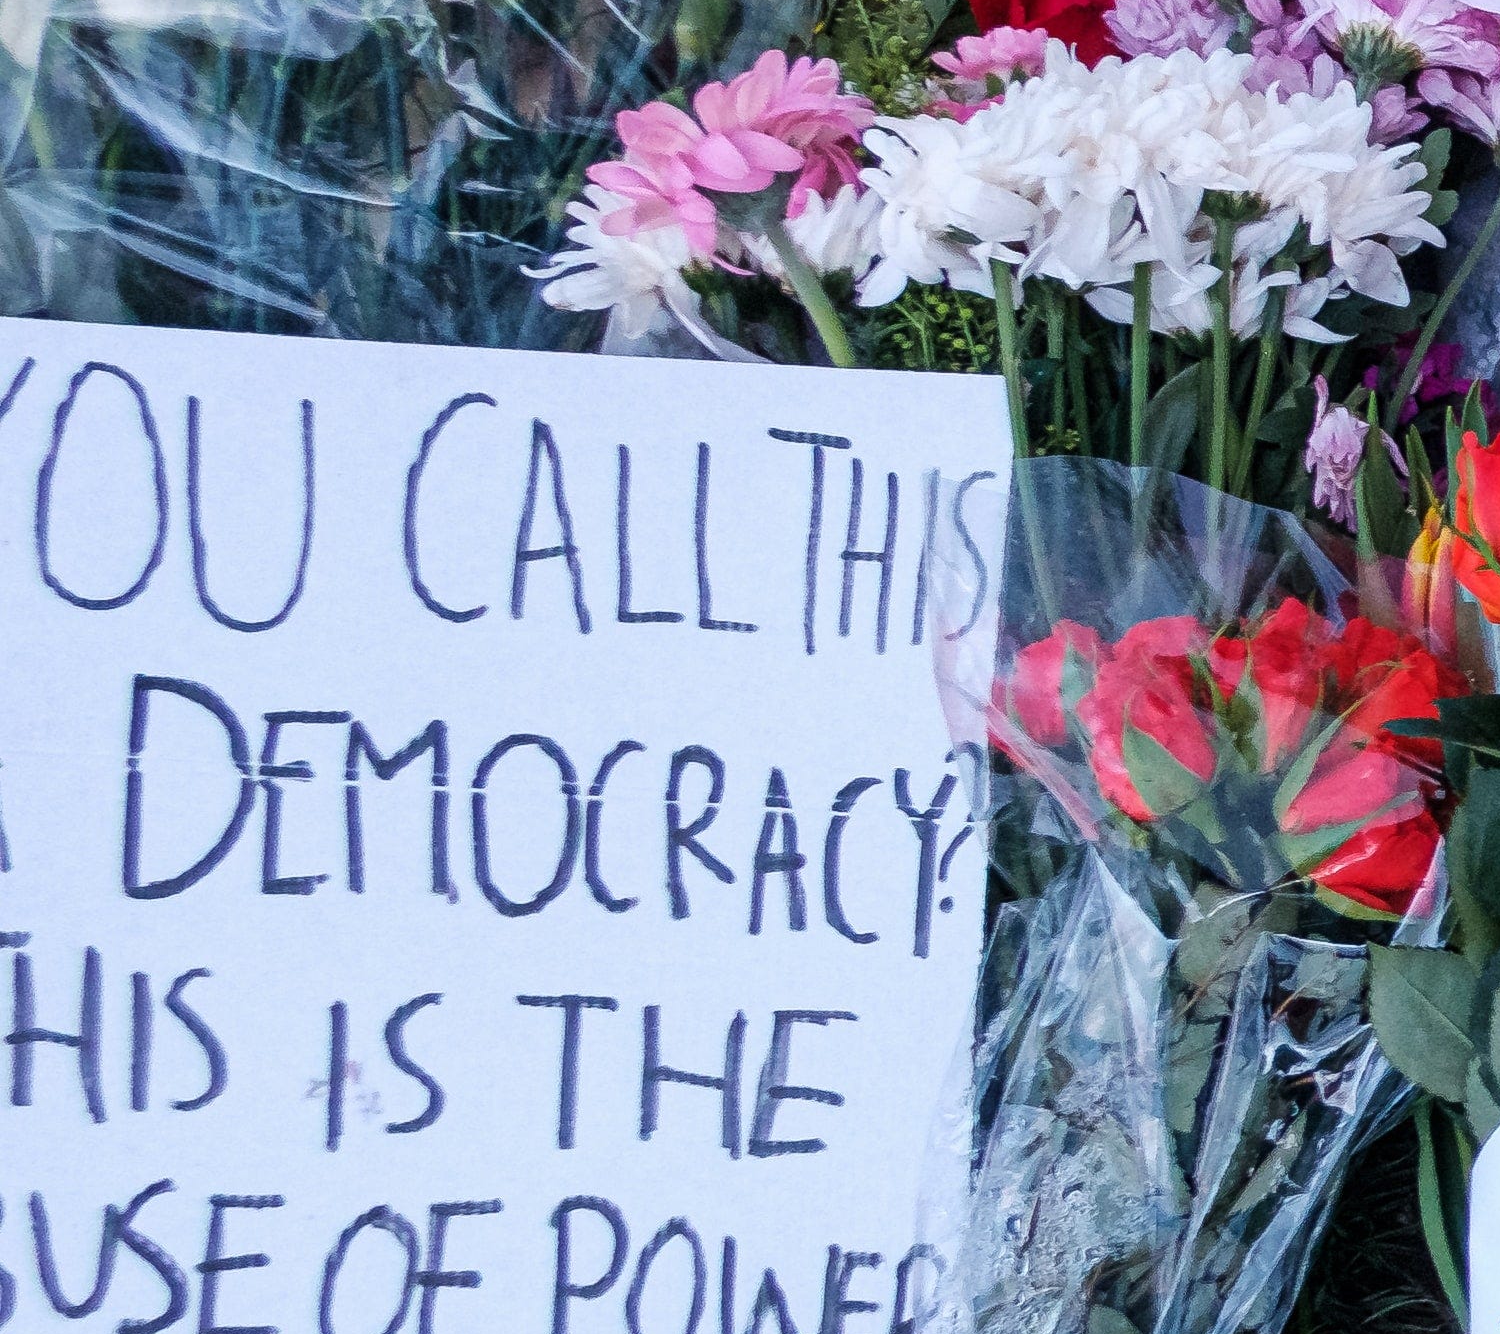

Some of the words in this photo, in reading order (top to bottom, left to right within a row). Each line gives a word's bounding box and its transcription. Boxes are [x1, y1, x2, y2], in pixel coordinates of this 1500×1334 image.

[0, 357, 316, 633] OU
[403, 391, 758, 635] CALL
[768, 425, 998, 657] THIS
[123, 673, 987, 959] DEMOCRACY?
[0, 929, 230, 1125] HIS
[328, 992, 446, 1152] IS
[516, 995, 859, 1161] THE
